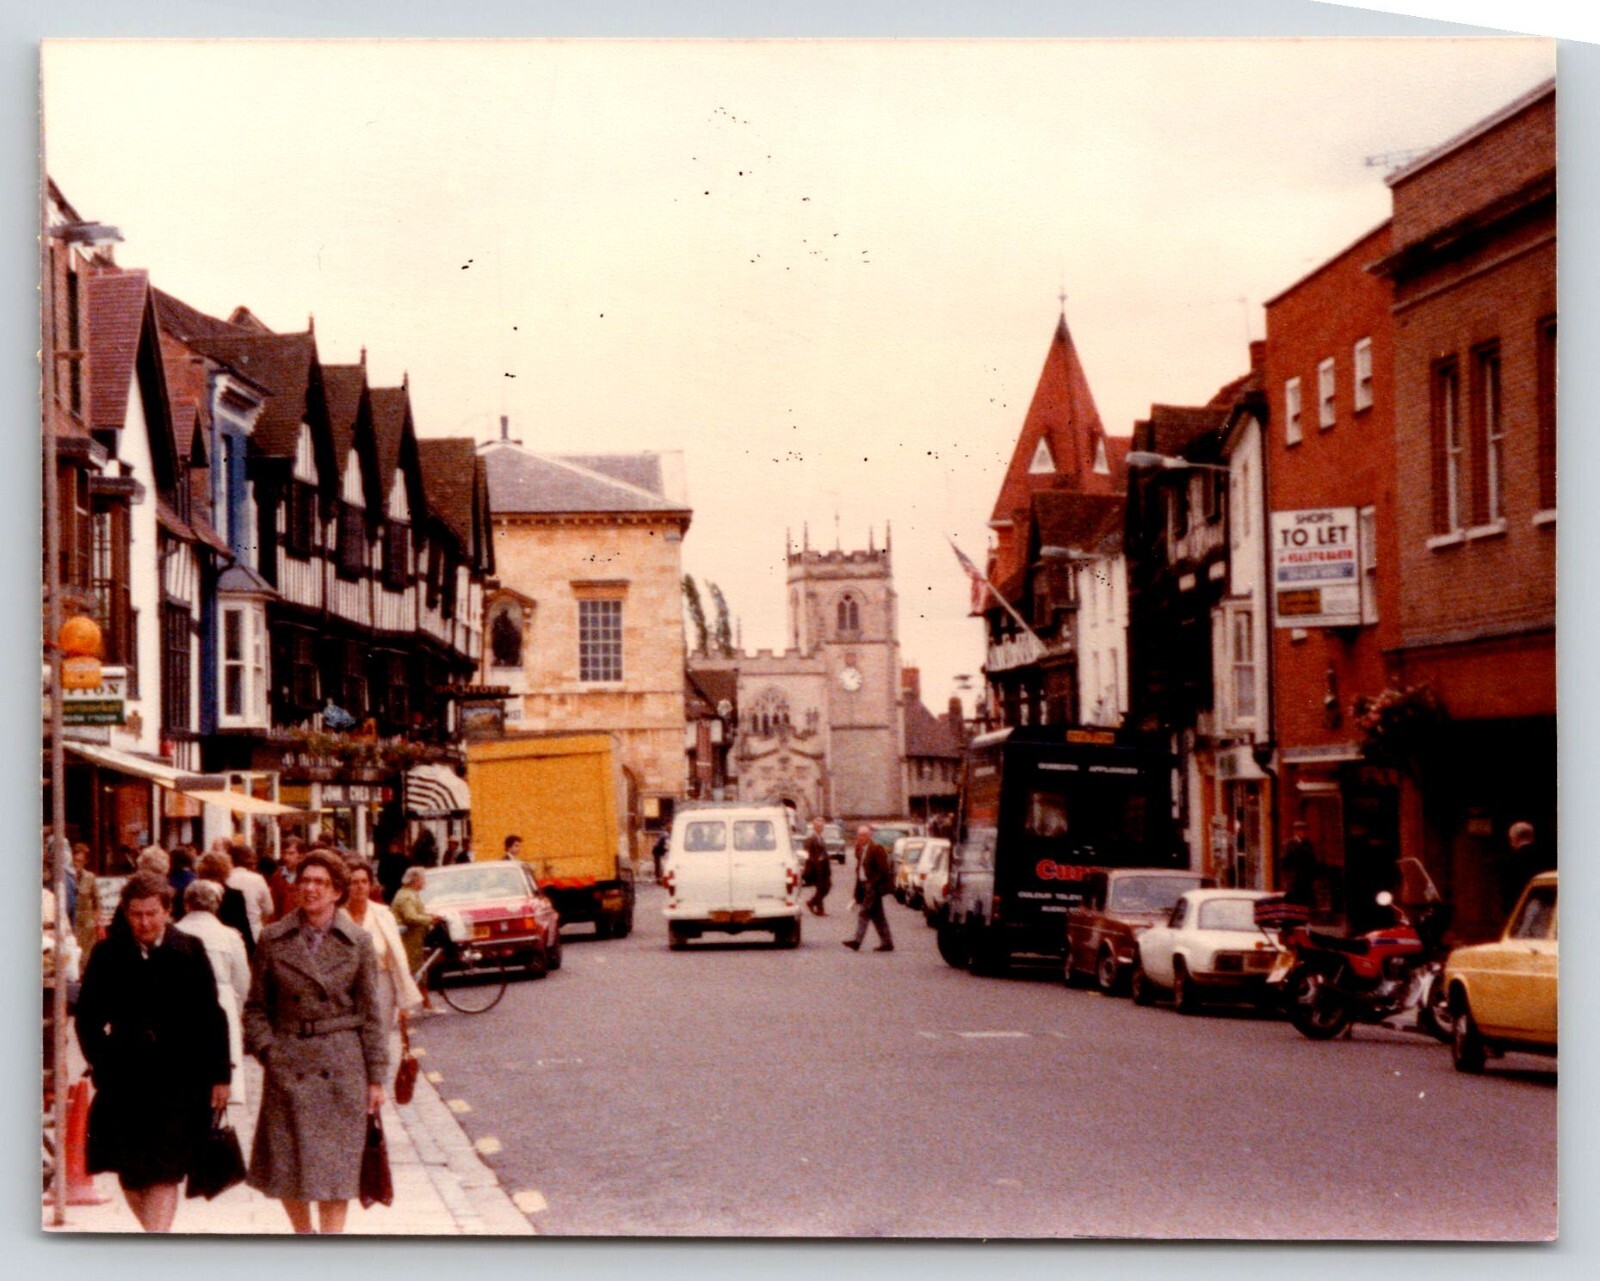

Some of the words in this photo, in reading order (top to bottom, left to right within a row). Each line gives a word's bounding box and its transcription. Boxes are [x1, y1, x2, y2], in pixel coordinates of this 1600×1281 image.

[1295, 513, 1333, 525] SHOPS
[1281, 528, 1308, 546] TO
[1317, 525, 1348, 545] LET
